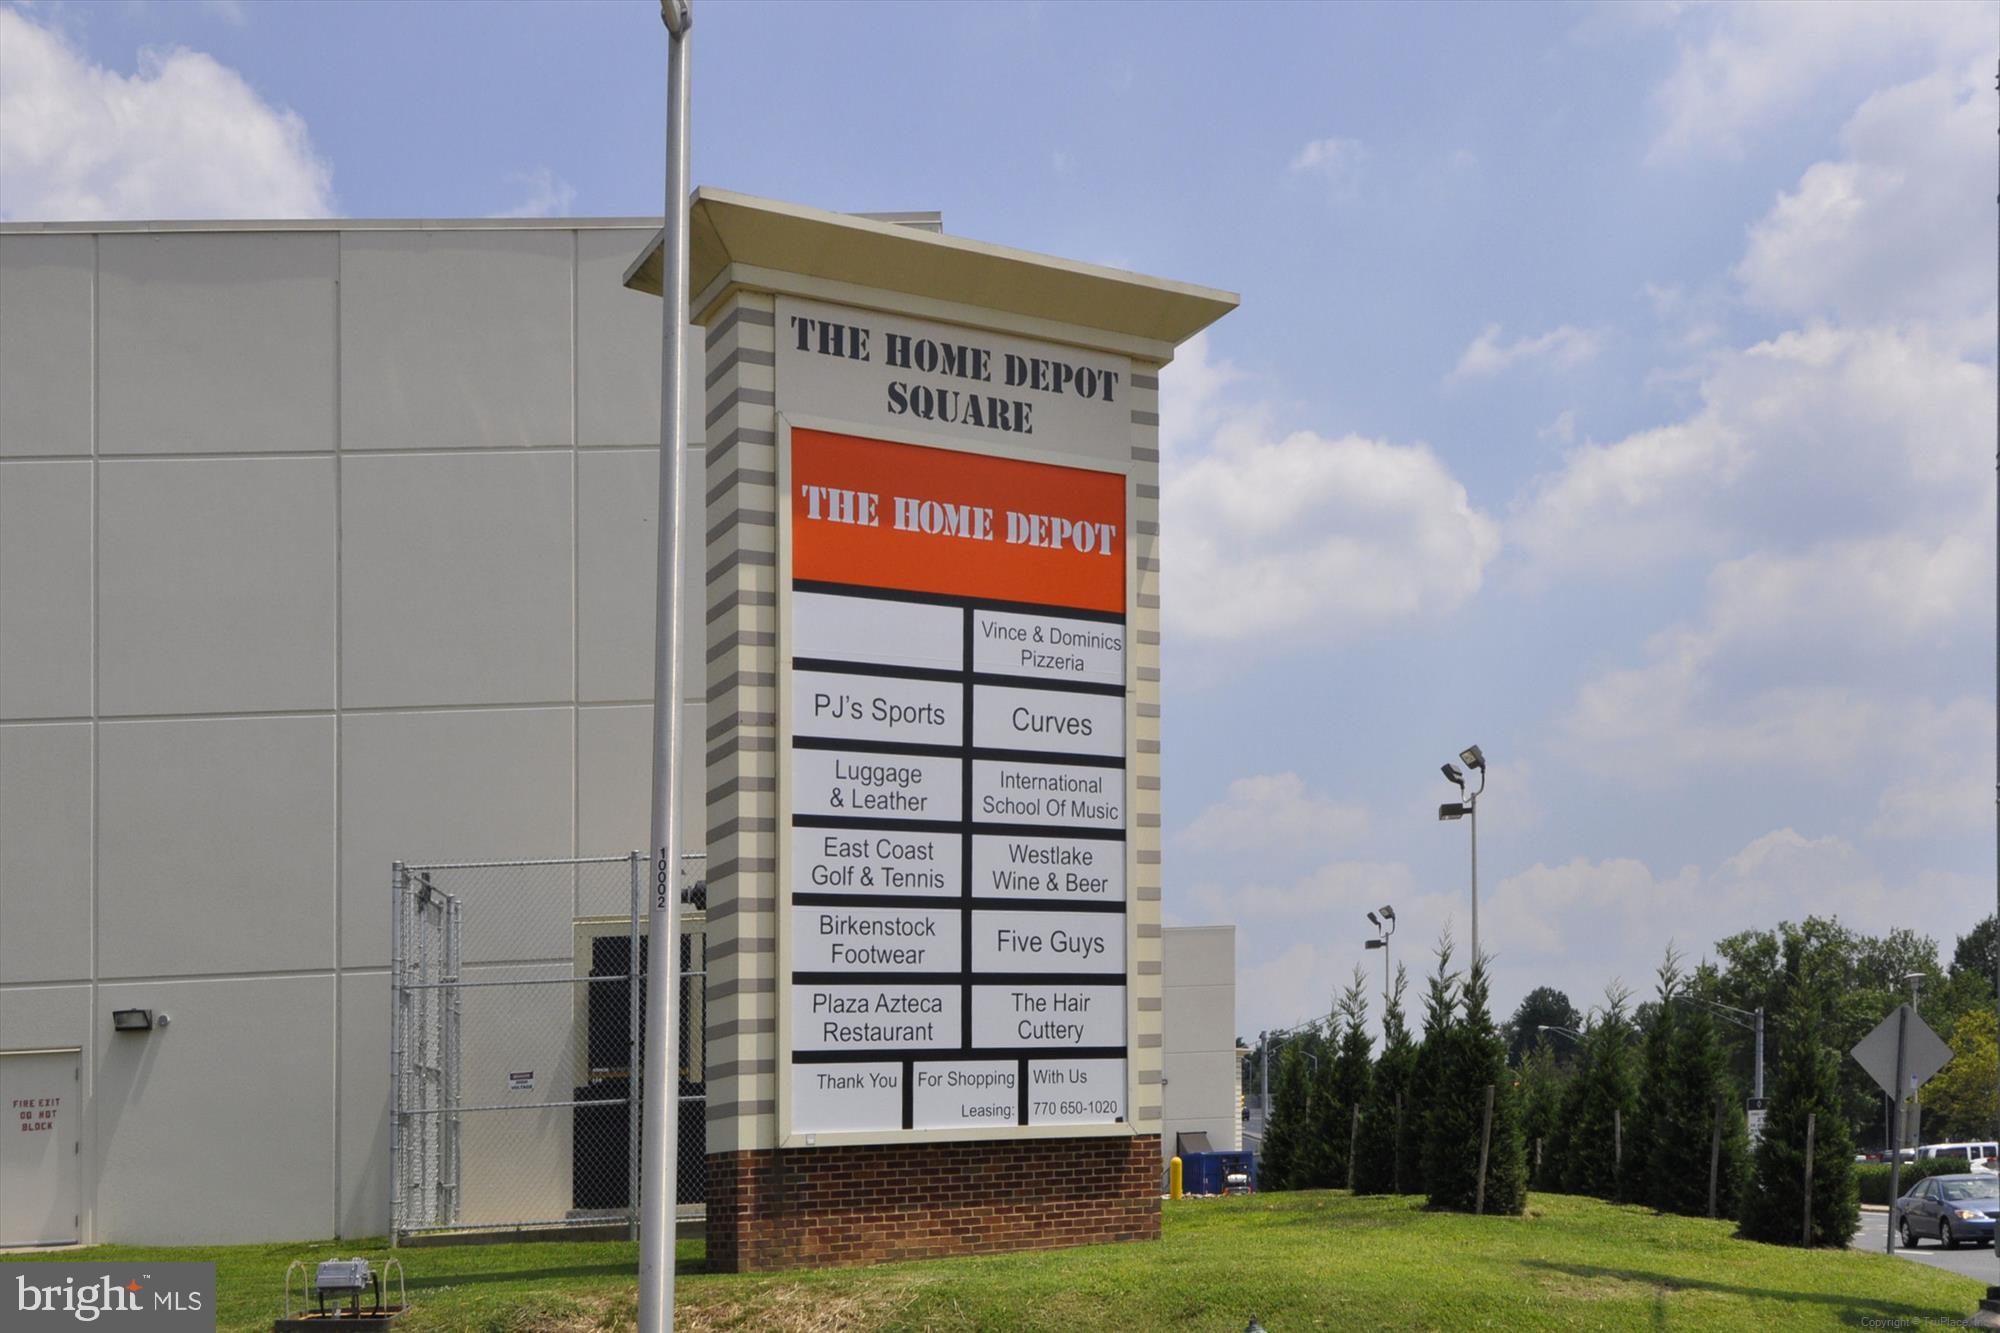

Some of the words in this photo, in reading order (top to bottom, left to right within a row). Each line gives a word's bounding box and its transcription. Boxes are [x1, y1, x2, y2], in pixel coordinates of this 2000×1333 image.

[791, 316, 869, 361] THE
[886, 333, 991, 382] HOME
[1004, 354, 1118, 402] DEPOT
[888, 381, 1032, 434] SQUARE
[802, 484, 878, 527] THE
[894, 497, 993, 541] HOME
[1006, 511, 1116, 556] DEPOT
[982, 621, 1027, 641] Vince
[1033, 626, 1044, 643] &
[1050, 628, 1122, 651] Dominics
[1021, 650, 1084, 671] Pizzeria
[815, 693, 863, 720] PJ's
[872, 698, 945, 727] Sports
[1012, 707, 1092, 736] Curves
[836, 759, 922, 787] Luggage
[1001, 770, 1102, 794] International
[830, 787, 844, 807] &
[852, 789, 927, 811] Leather
[983, 796, 1039, 816] School
[1046, 799, 1066, 816] Of
[1071, 801, 1118, 820] Music
[824, 837, 869, 858] East
[876, 839, 933, 860] Coast
[1009, 844, 1092, 865] Westlake
[657, 847, 667, 908] 10002
[812, 865, 854, 886] Golf
[860, 866, 874, 886] &
[881, 867, 944, 888] Tennis
[992, 870, 1040, 891] Wine
[1046, 872, 1059, 891] &
[1066, 873, 1108, 893] Beer
[820, 914, 935, 936] Birkenstock
[831, 943, 925, 964] Footwear
[997, 930, 1042, 953] Five
[1050, 930, 1105, 958] Guys
[813, 993, 869, 1014] Plaza
[875, 993, 942, 1013] Azteca
[1012, 993, 1046, 1012] The
[1053, 992, 1090, 1012] Hair
[823, 1021, 933, 1042] Restaurant
[1017, 1020, 1084, 1043] Cuttery
[817, 1073, 864, 1089] Thank
[869, 1072, 897, 1088] You
[918, 1071, 943, 1087] For
[947, 1070, 1015, 1088] Shopping
[1033, 1070, 1064, 1084] With
[1069, 1069, 1087, 1084] Us
[13, 1100, 35, 1108] FIRE
[39, 1098, 60, 1107] EXIT
[961, 1103, 1015, 1119] Leasing:
[1033, 1102, 1056, 1115] 770
[1060, 1100, 1117, 1115] 650-1020
[20, 1111, 32, 1120] DO
[39, 1110, 57, 1118] NOT
[22, 1122, 53, 1131] BLOCK
